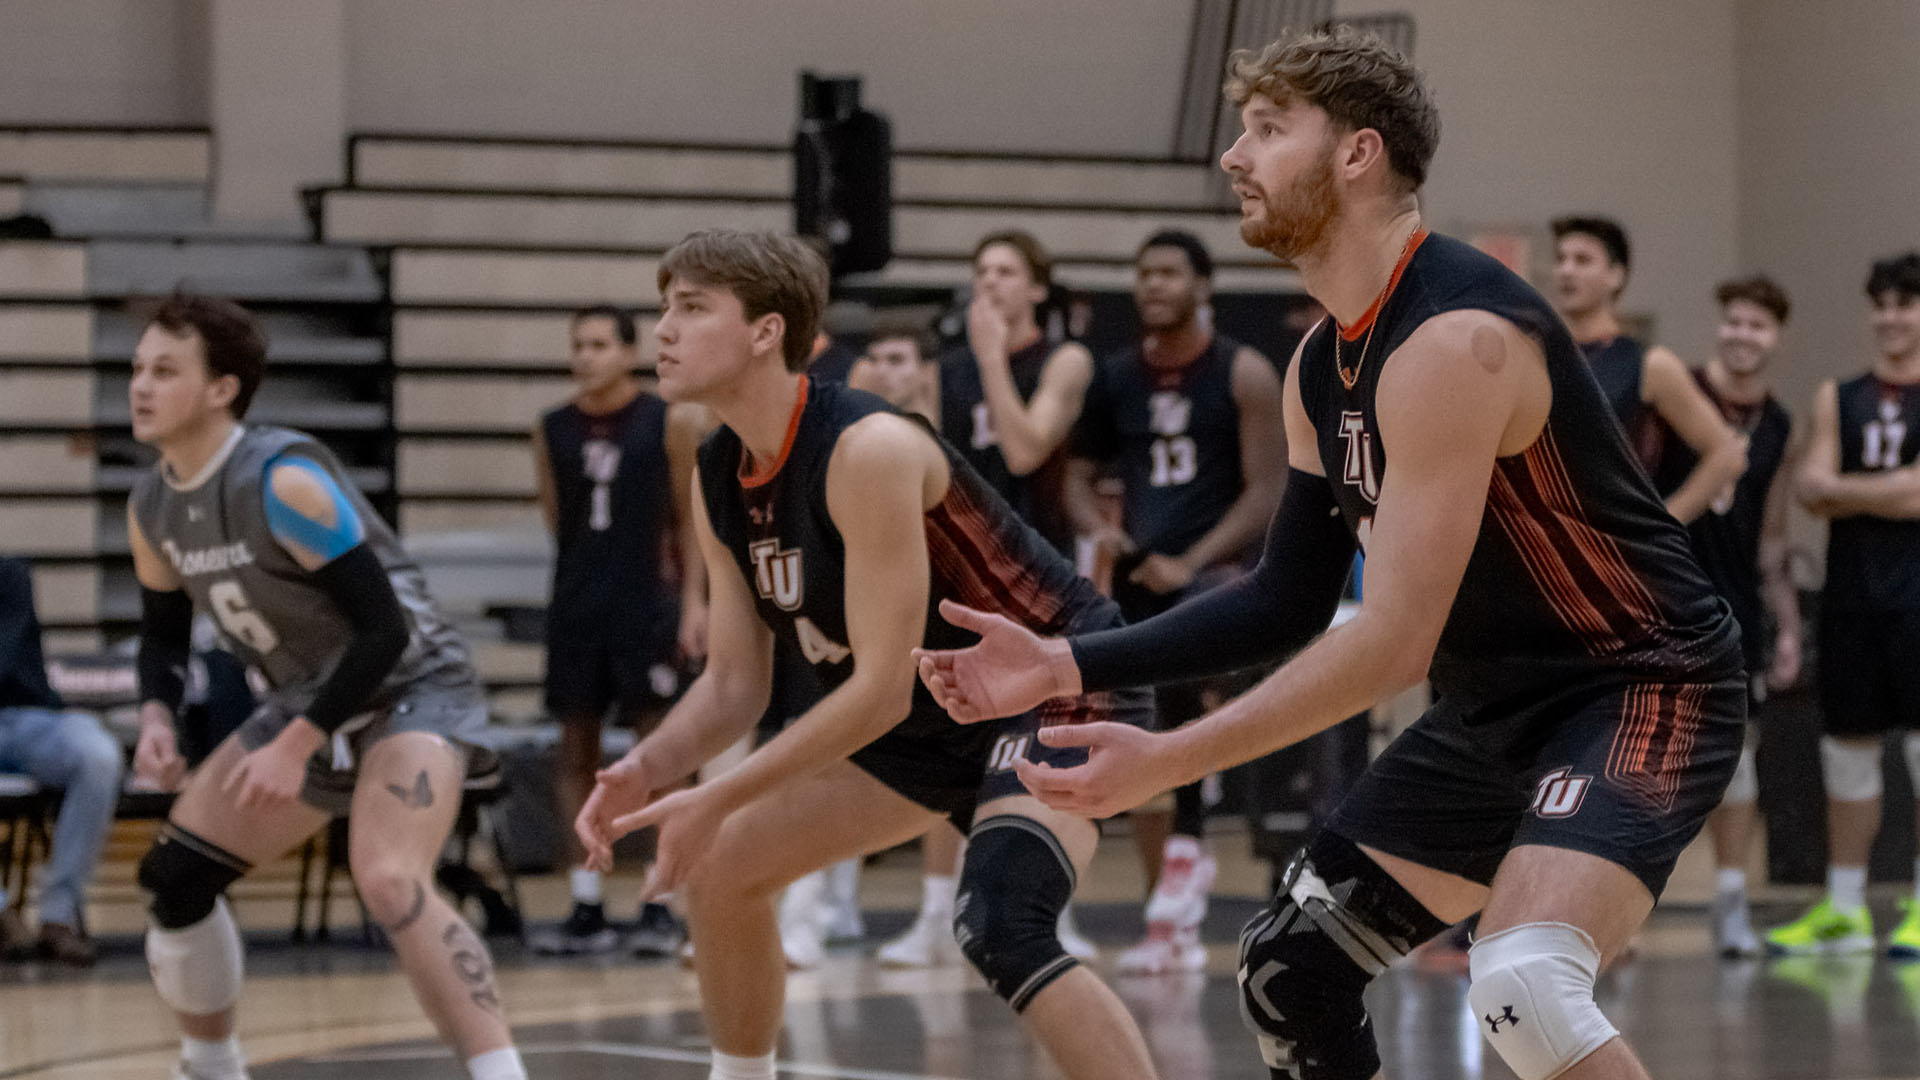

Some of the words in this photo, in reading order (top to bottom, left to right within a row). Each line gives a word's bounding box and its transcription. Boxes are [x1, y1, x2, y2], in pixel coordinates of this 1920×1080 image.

[1150, 434, 1197, 487] 13
[589, 482, 612, 531] 1
[749, 538, 803, 612] TU
[208, 580, 279, 655] 6
[794, 616, 852, 665] 4
[1529, 765, 1594, 819] TU
